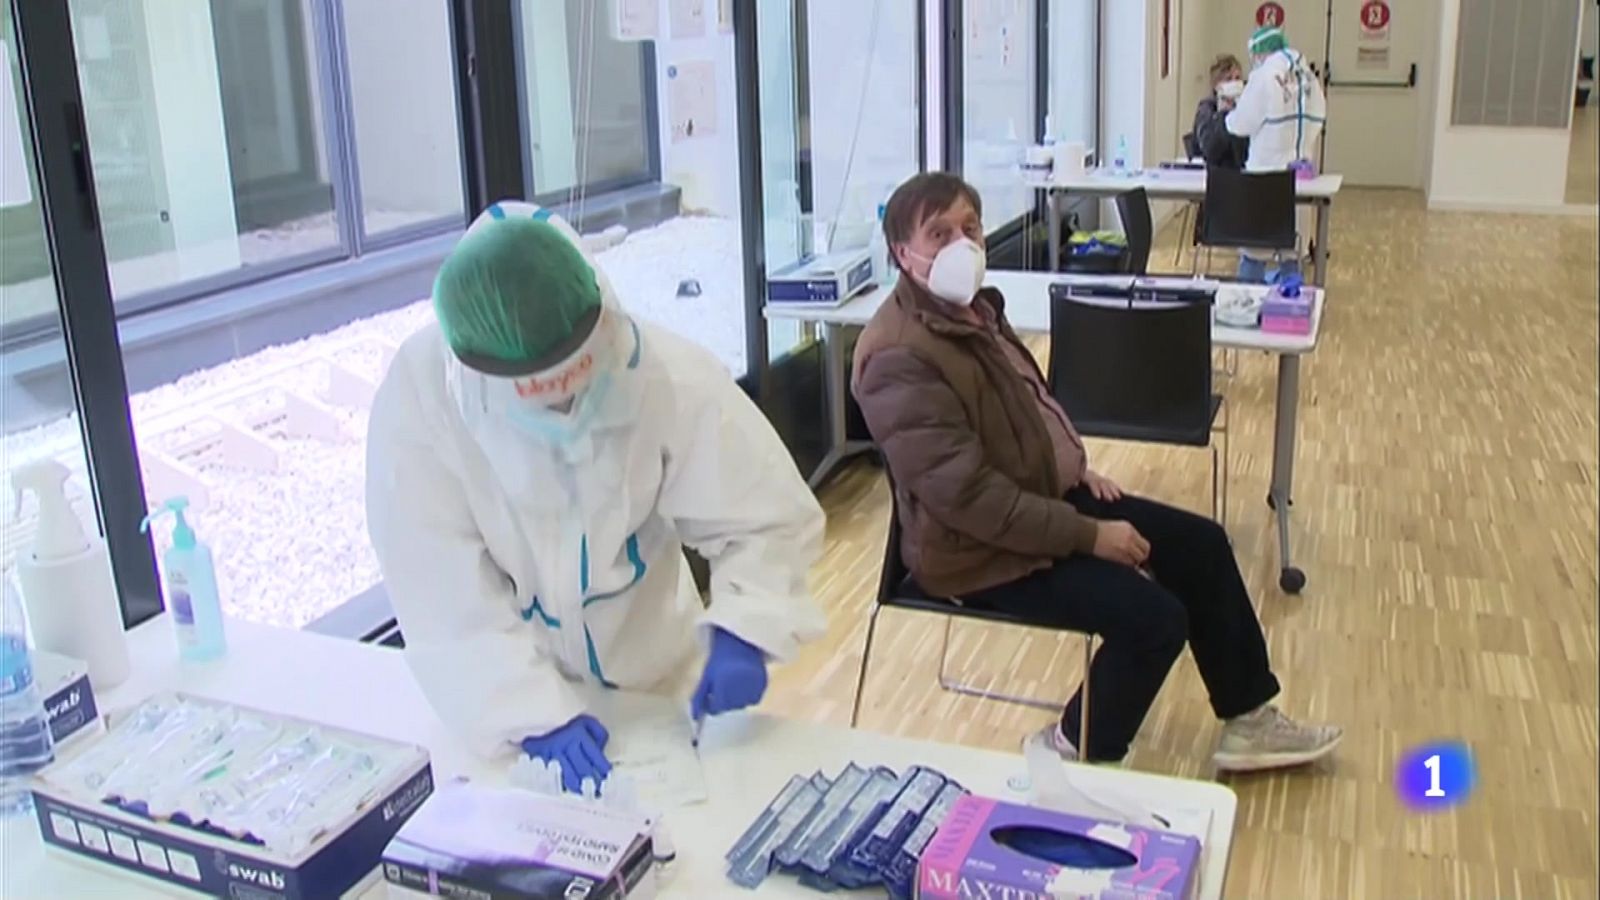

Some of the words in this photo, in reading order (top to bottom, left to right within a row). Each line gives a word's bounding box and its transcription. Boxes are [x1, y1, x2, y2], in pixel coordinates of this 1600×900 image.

[49, 687, 80, 717] wab
[229, 864, 285, 891] swab
[928, 868, 1052, 900] MAXT
